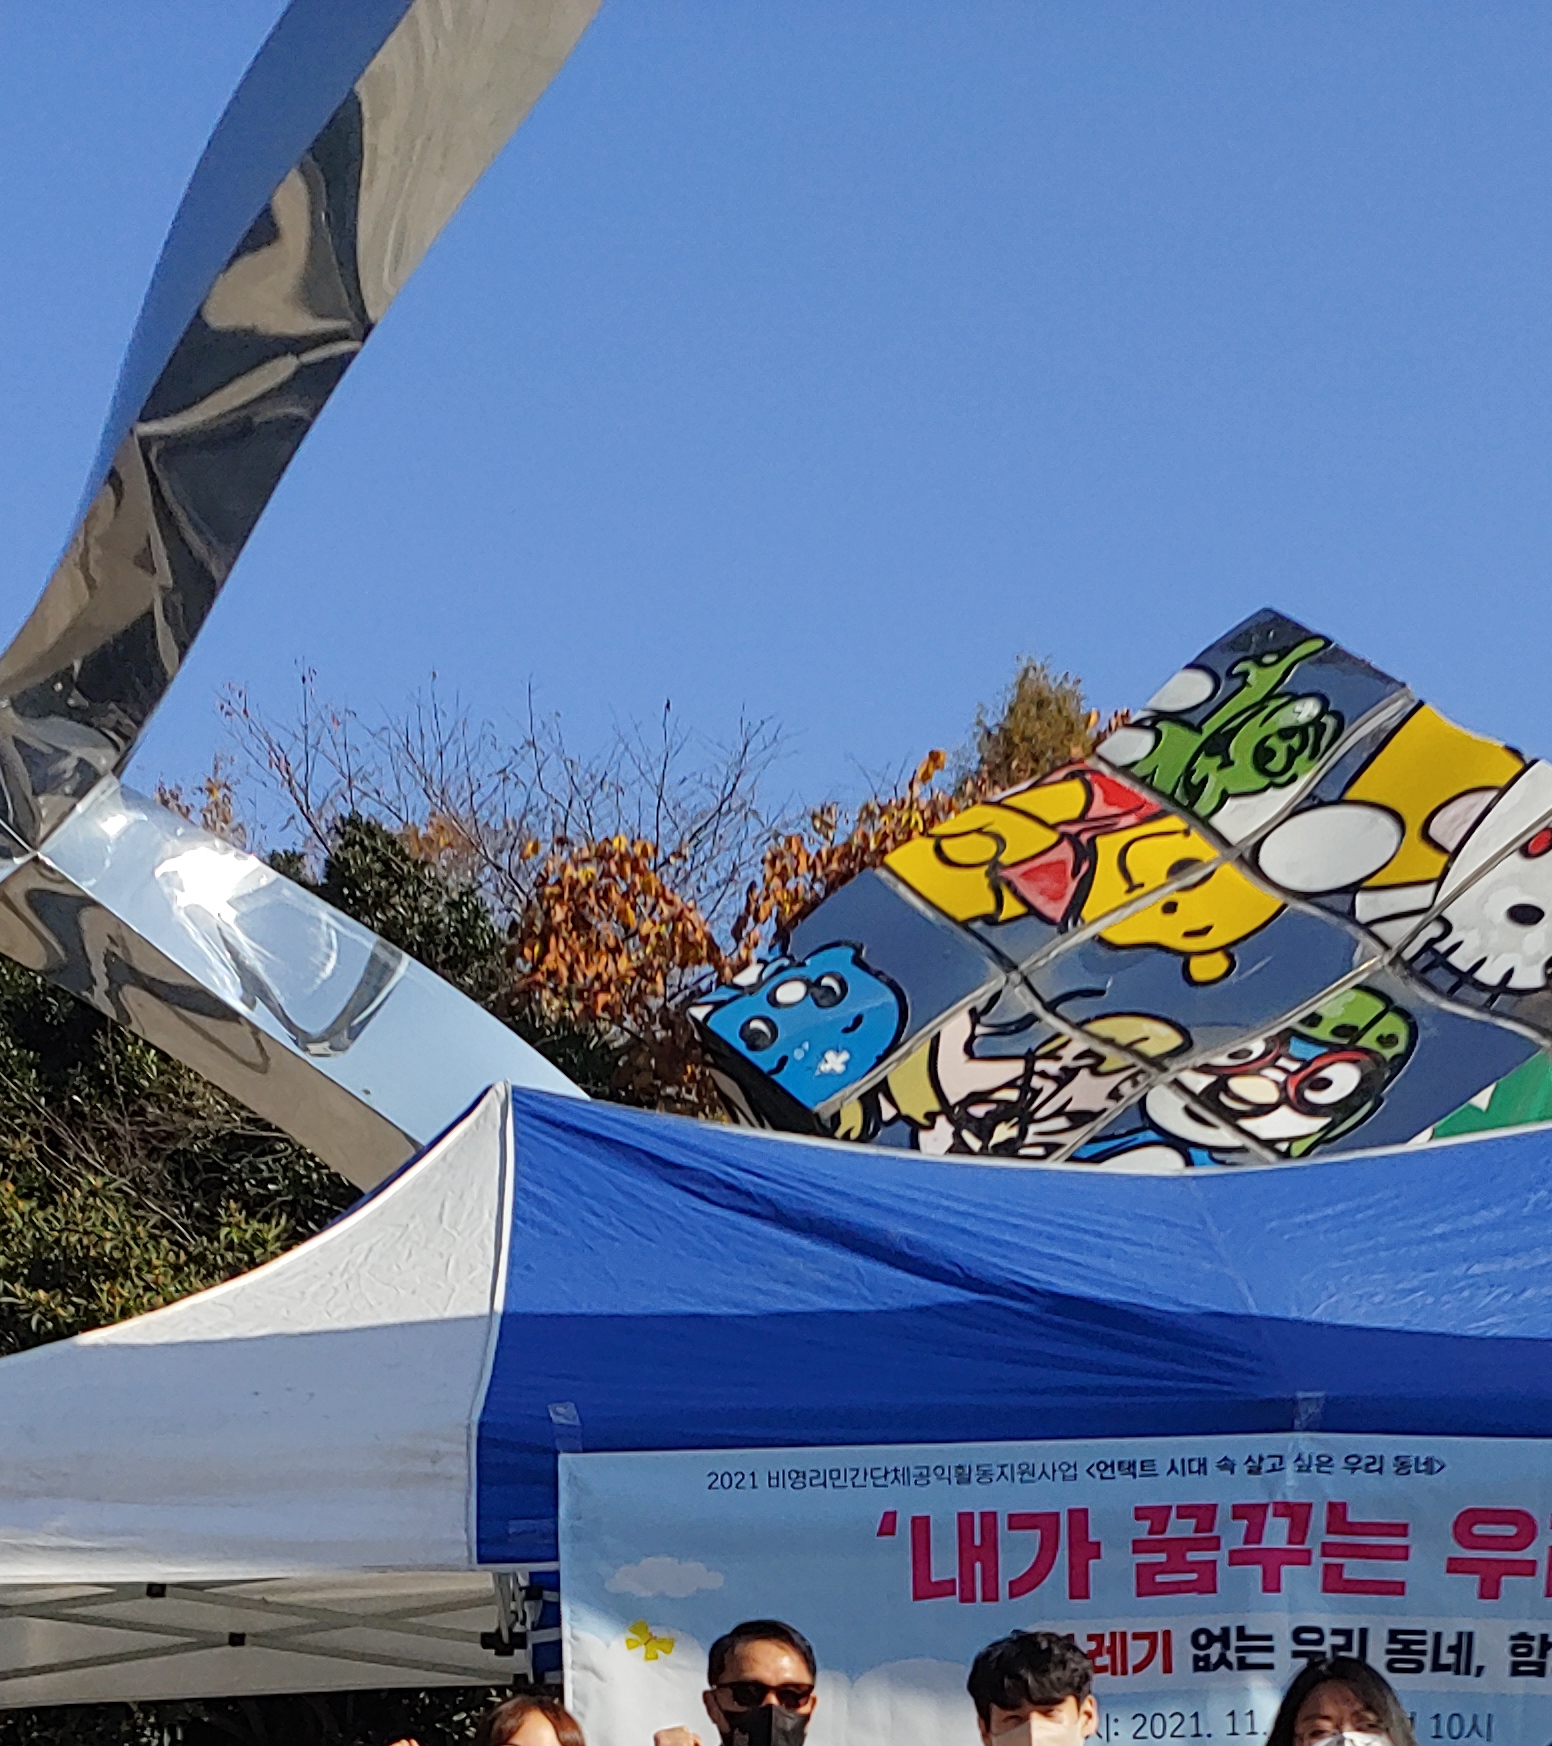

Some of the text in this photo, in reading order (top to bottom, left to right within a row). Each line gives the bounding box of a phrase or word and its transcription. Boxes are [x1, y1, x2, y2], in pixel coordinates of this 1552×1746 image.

[707, 1453, 1446, 1490] 2021 비영리민간단체공익활동지원사업 <언택트 시대 속 살고 싶은 우리 동네>
[1131, 1501, 1411, 1598] 꿈꾸는
[1066, 1630, 1174, 1676] 레기
[1191, 1626, 1275, 1673] 없는
[1292, 1625, 1369, 1665] 우리
[1385, 1629, 1486, 1678] 동네,
[1131, 1710, 1494, 1742] 2021. 11. 10시
